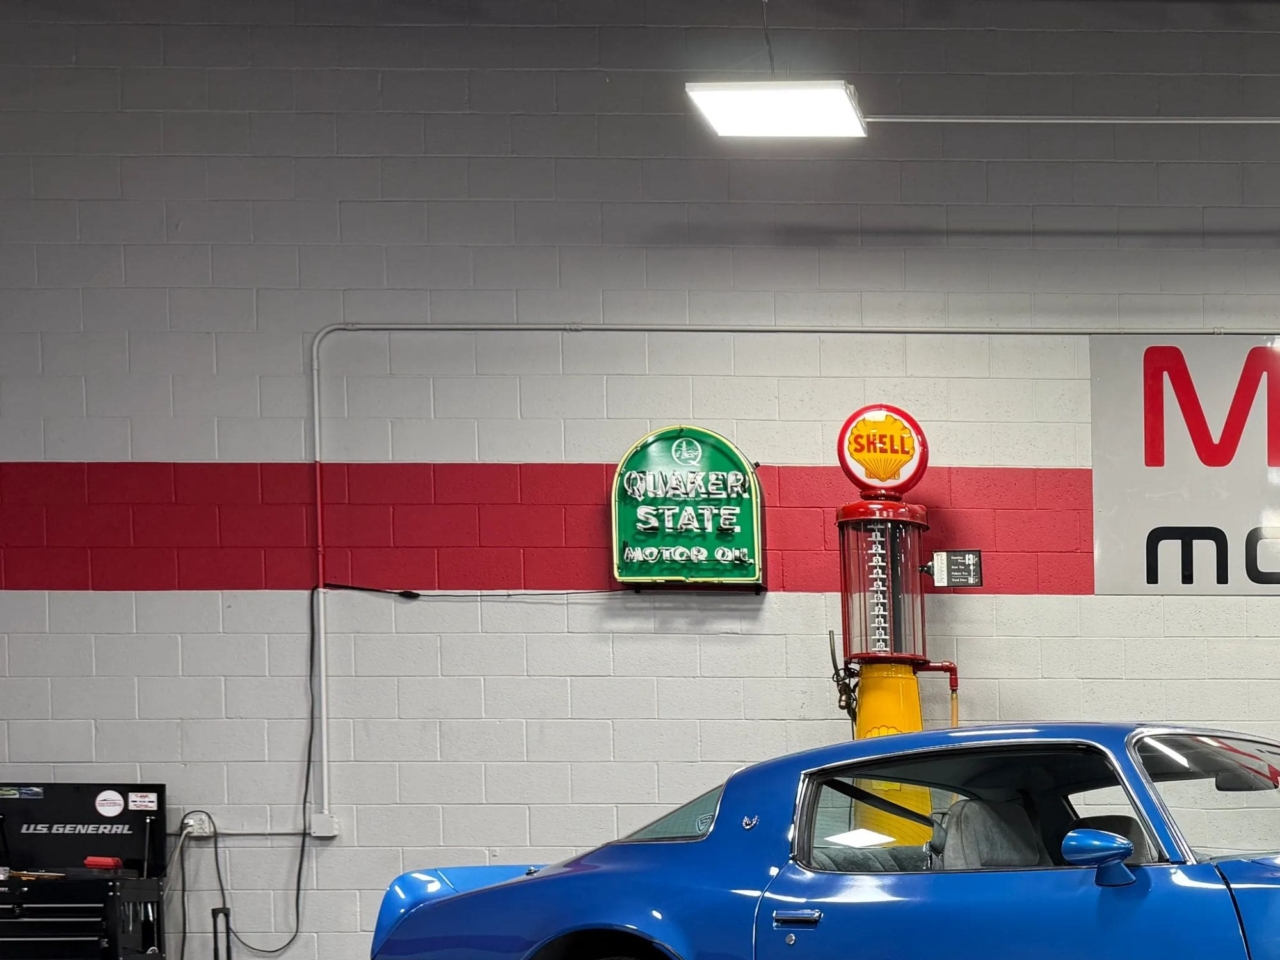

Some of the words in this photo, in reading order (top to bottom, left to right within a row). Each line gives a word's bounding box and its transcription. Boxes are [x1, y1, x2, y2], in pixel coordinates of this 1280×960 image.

[853, 433, 910, 455] SHELL
[623, 470, 750, 501] QUAKER
[636, 505, 742, 533] STATE
[623, 546, 709, 563] MOTOR
[715, 546, 754, 564] OIL
[51, 824, 133, 834] GENERAL
